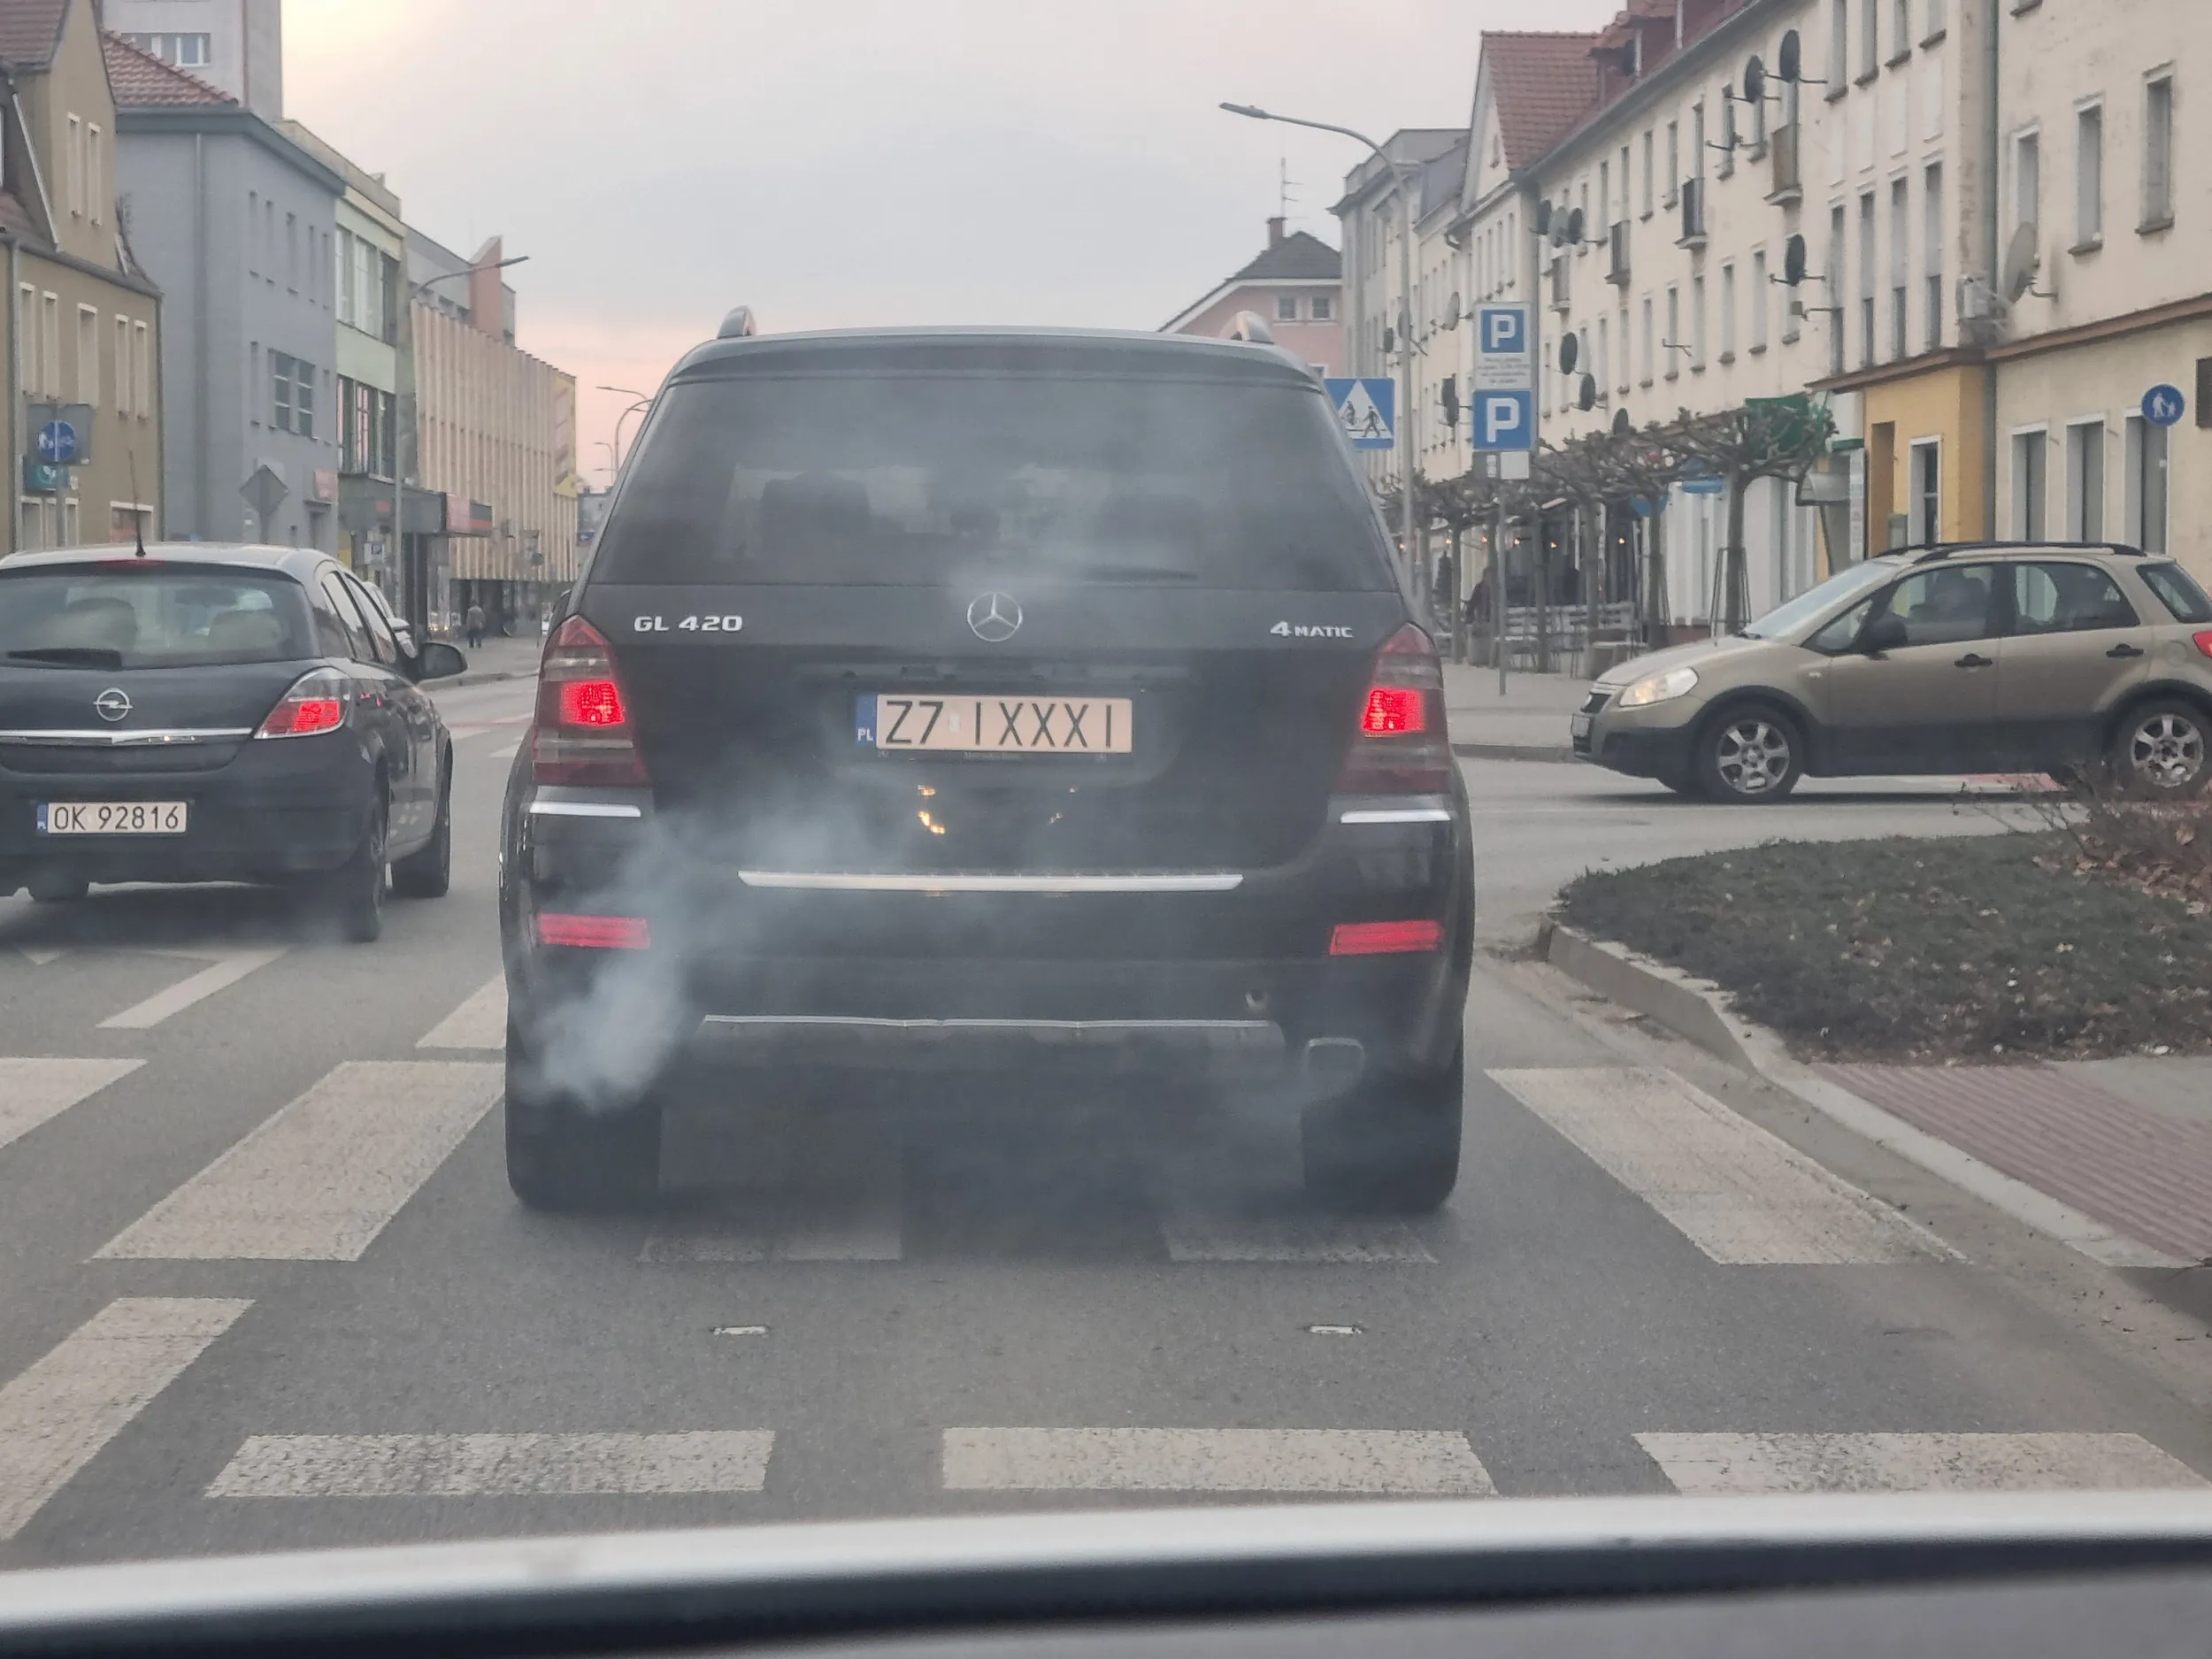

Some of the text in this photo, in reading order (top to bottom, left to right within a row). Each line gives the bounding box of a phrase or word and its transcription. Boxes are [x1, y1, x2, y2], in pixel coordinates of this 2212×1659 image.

[1490, 314, 1517, 349] P
[1486, 397, 1520, 442] P
[634, 615, 743, 632] GL 420
[857, 727, 874, 741] PL
[886, 700, 944, 745] Z7
[54, 805, 179, 831] OK 92816
